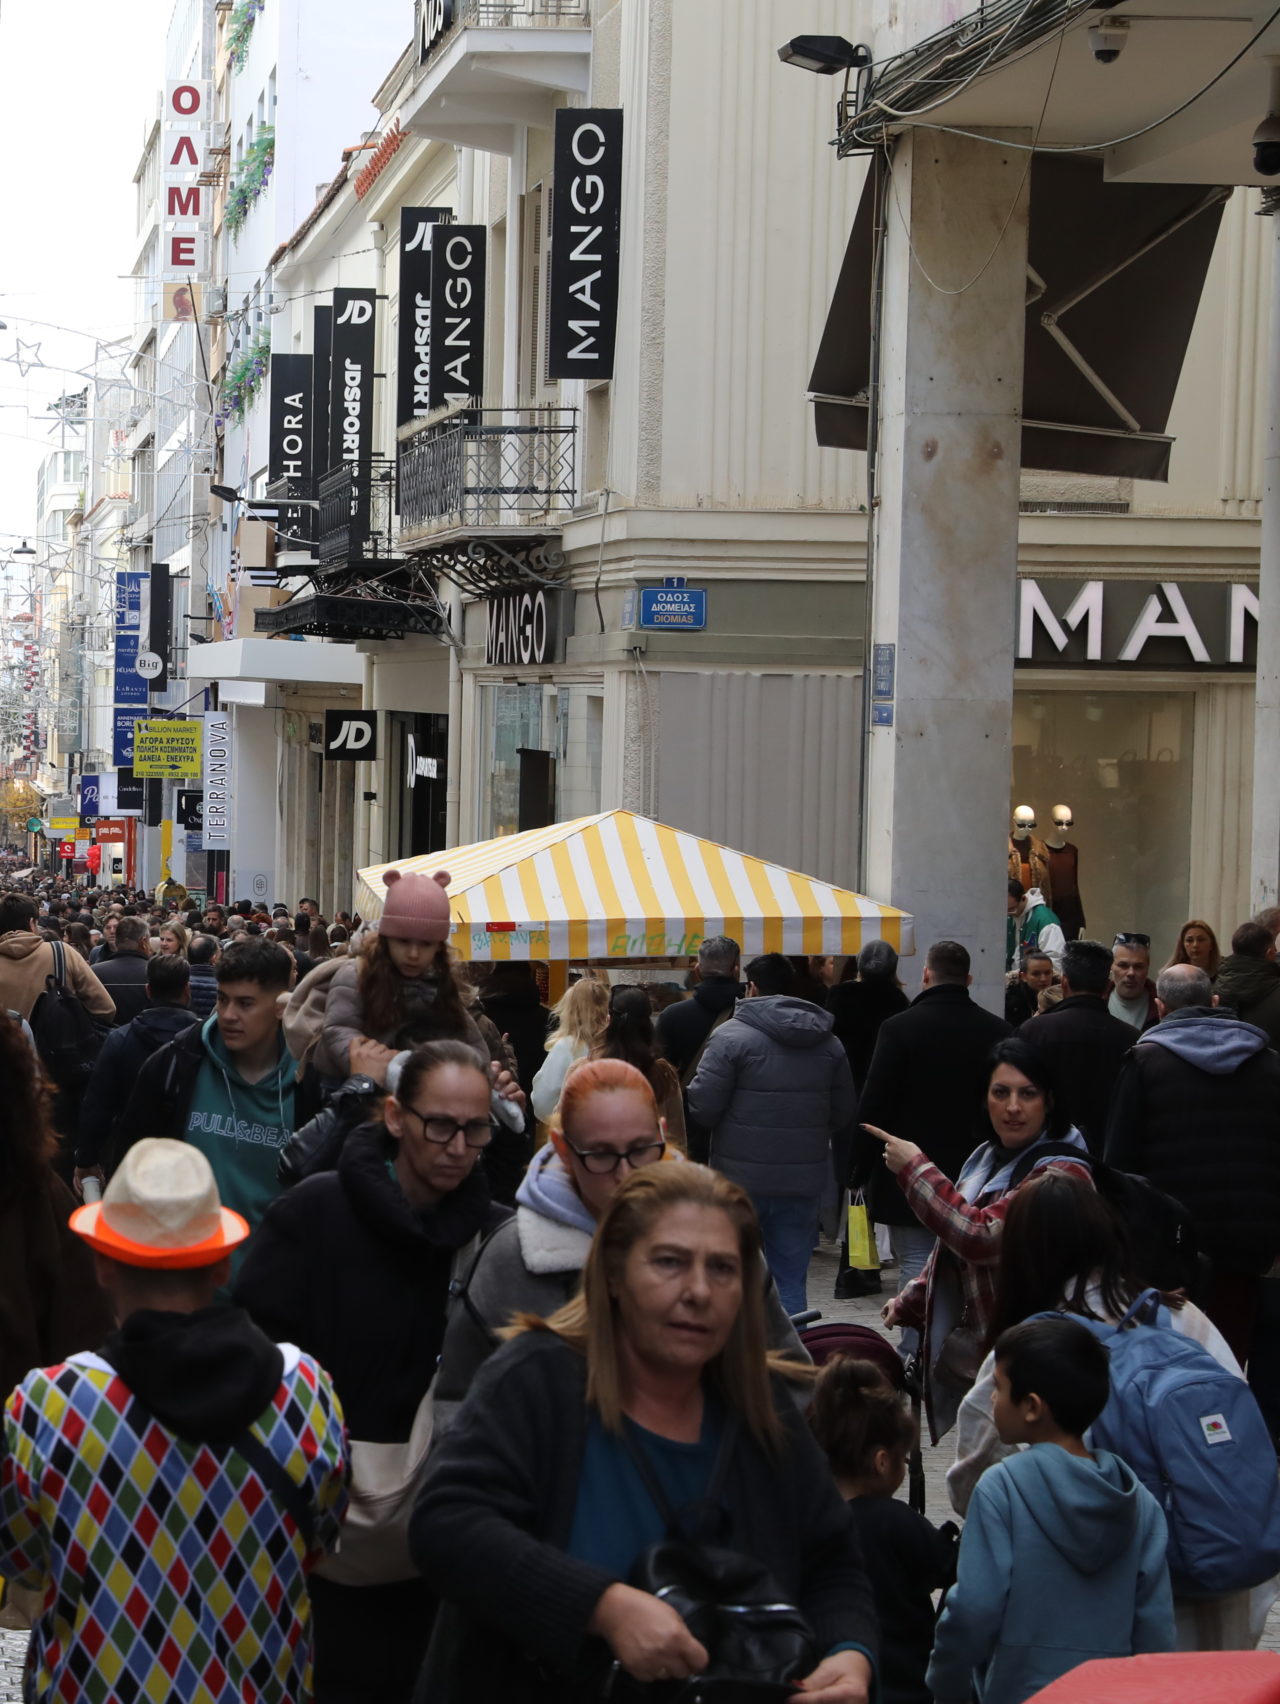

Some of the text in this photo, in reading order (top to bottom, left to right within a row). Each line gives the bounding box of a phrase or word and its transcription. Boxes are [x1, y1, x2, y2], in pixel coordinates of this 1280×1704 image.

[566, 122, 606, 360] MANGO
[336, 300, 372, 325] JD
[657, 593, 690, 602] ΟΔΟΣ
[651, 603, 696, 612] ΔΙΟΜΕΙΑΣ
[654, 614, 694, 624] DIOMIAS
[484, 590, 547, 665] MANGO
[139, 660, 158, 670] Big
[148, 726, 197, 734] BILLION MARKET
[329, 720, 372, 750] JD
[139, 737, 195, 745] ΑΓΟΡΑ ΧΡΥΣΟΥ
[138, 754, 162, 762] ΔΑΝΕΙΑ
[208, 721, 227, 841] TERRANOVA
